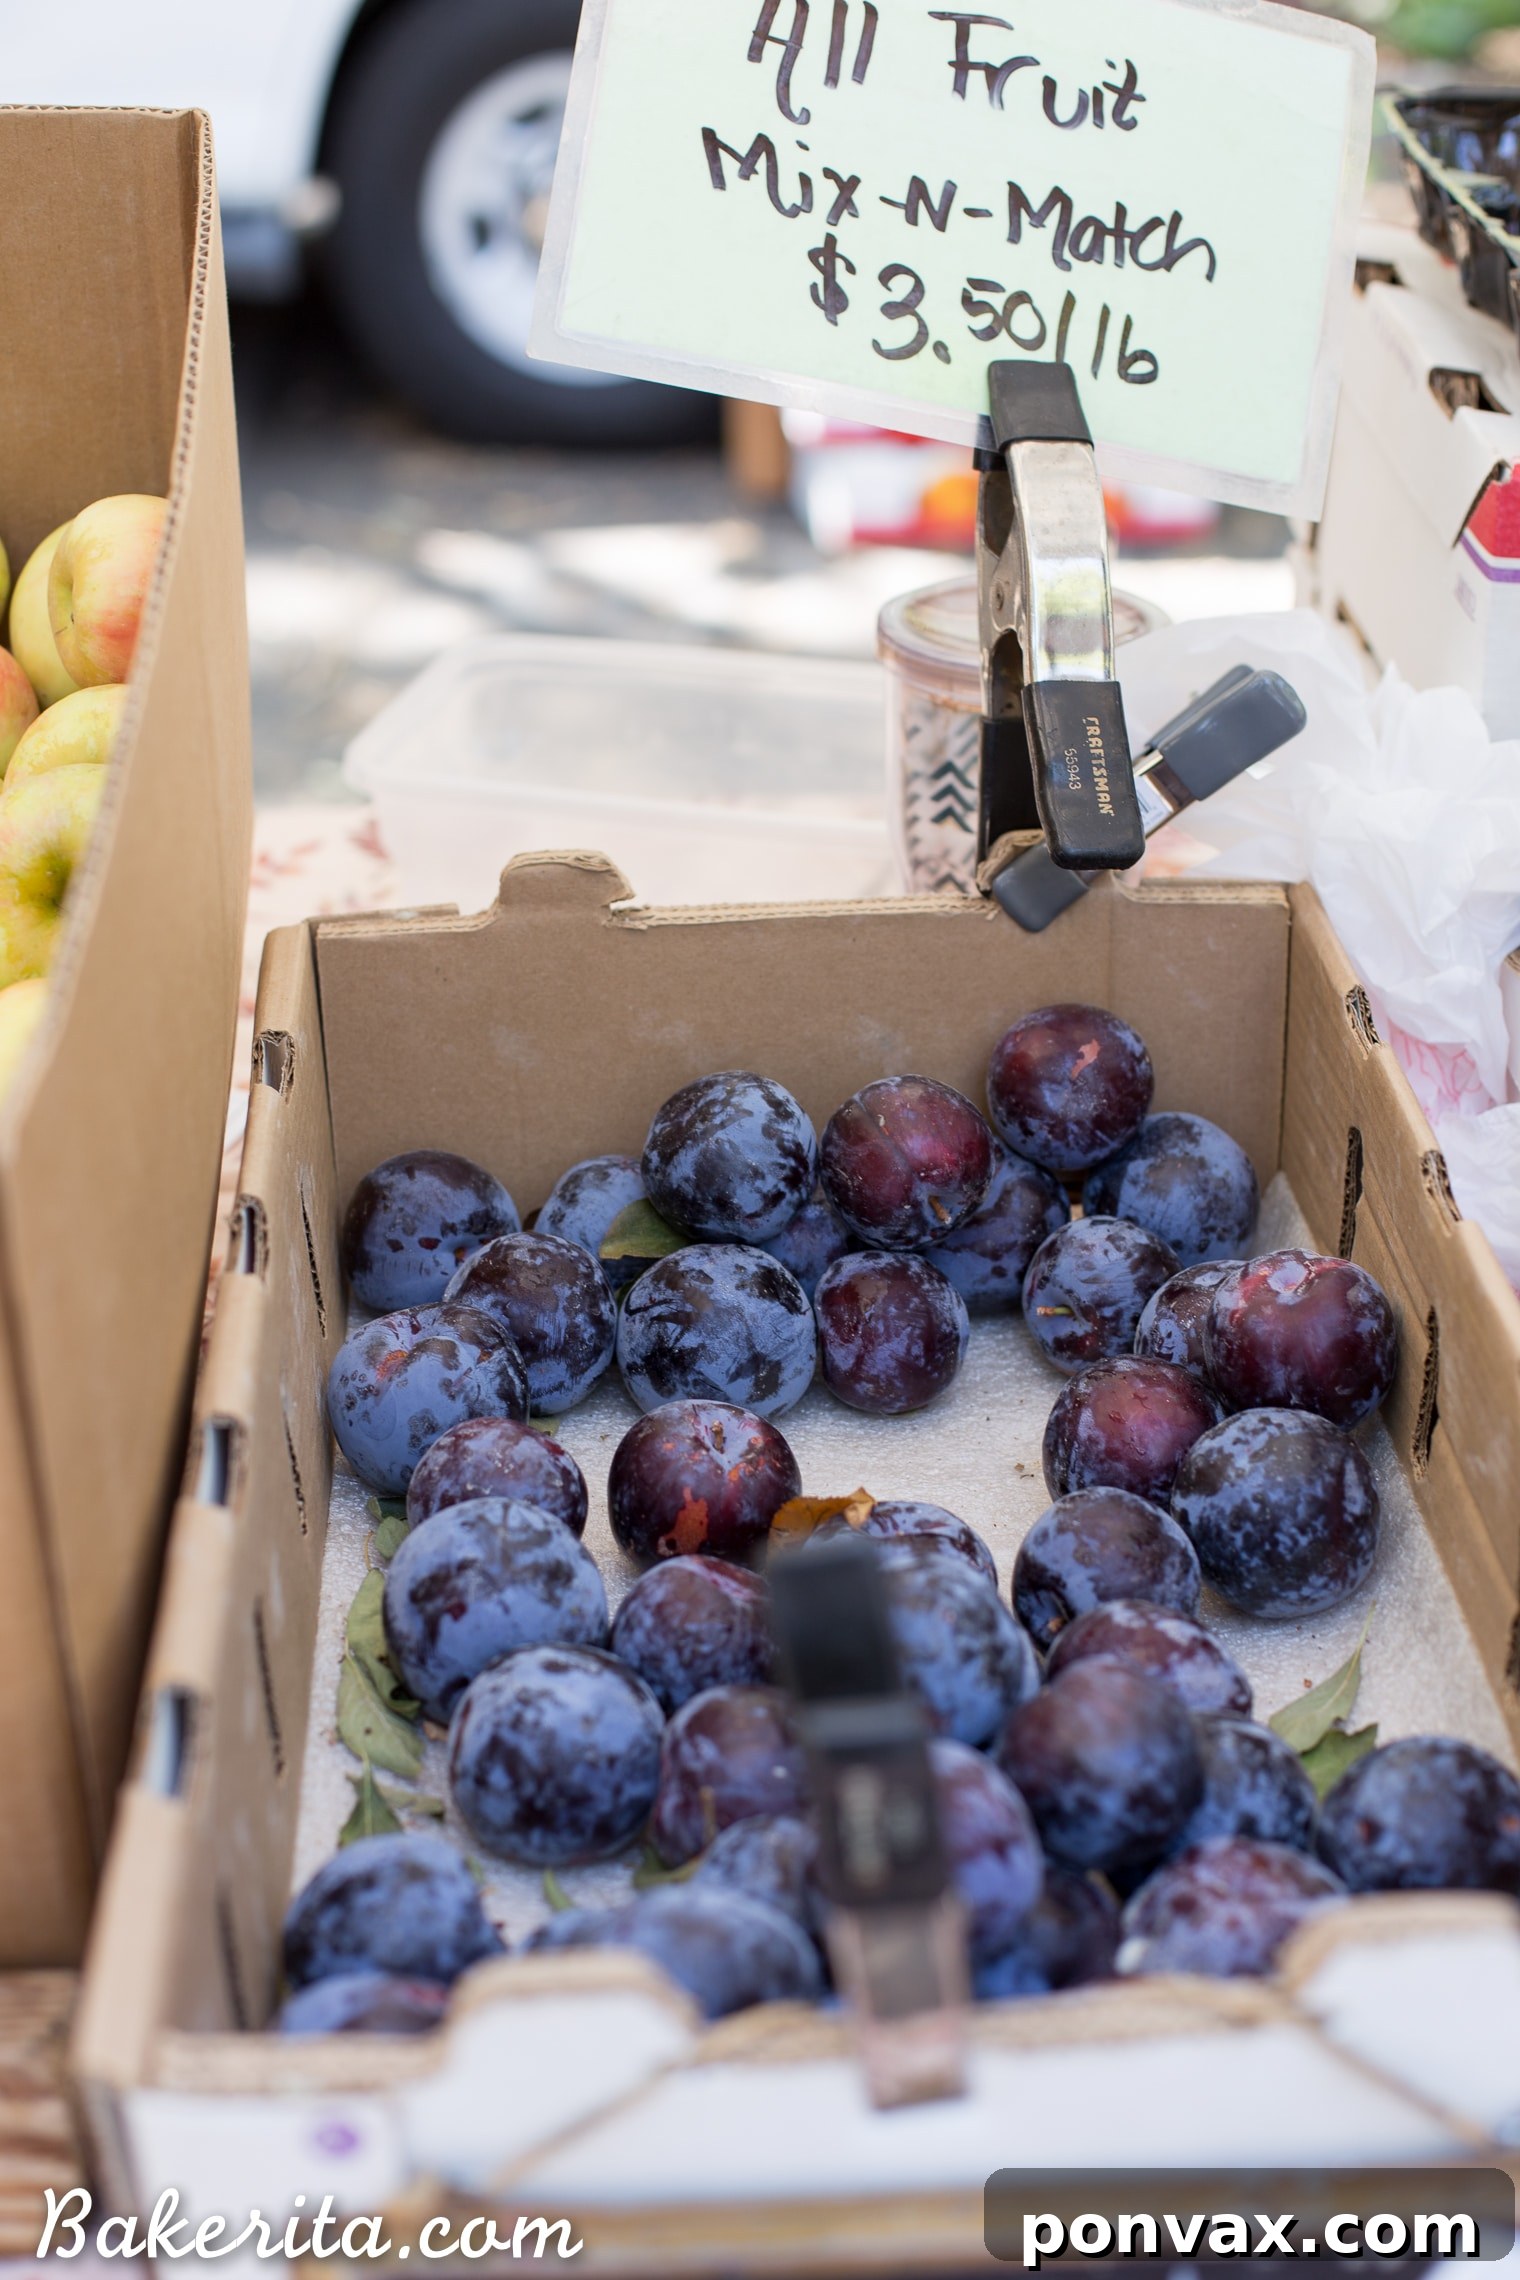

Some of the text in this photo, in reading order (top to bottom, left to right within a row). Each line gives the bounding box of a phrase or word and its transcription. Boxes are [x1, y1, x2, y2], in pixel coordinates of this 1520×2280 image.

[747, 0, 1148, 131] All Fruit
[1082, 716, 1115, 817] CRAFTSMAN
